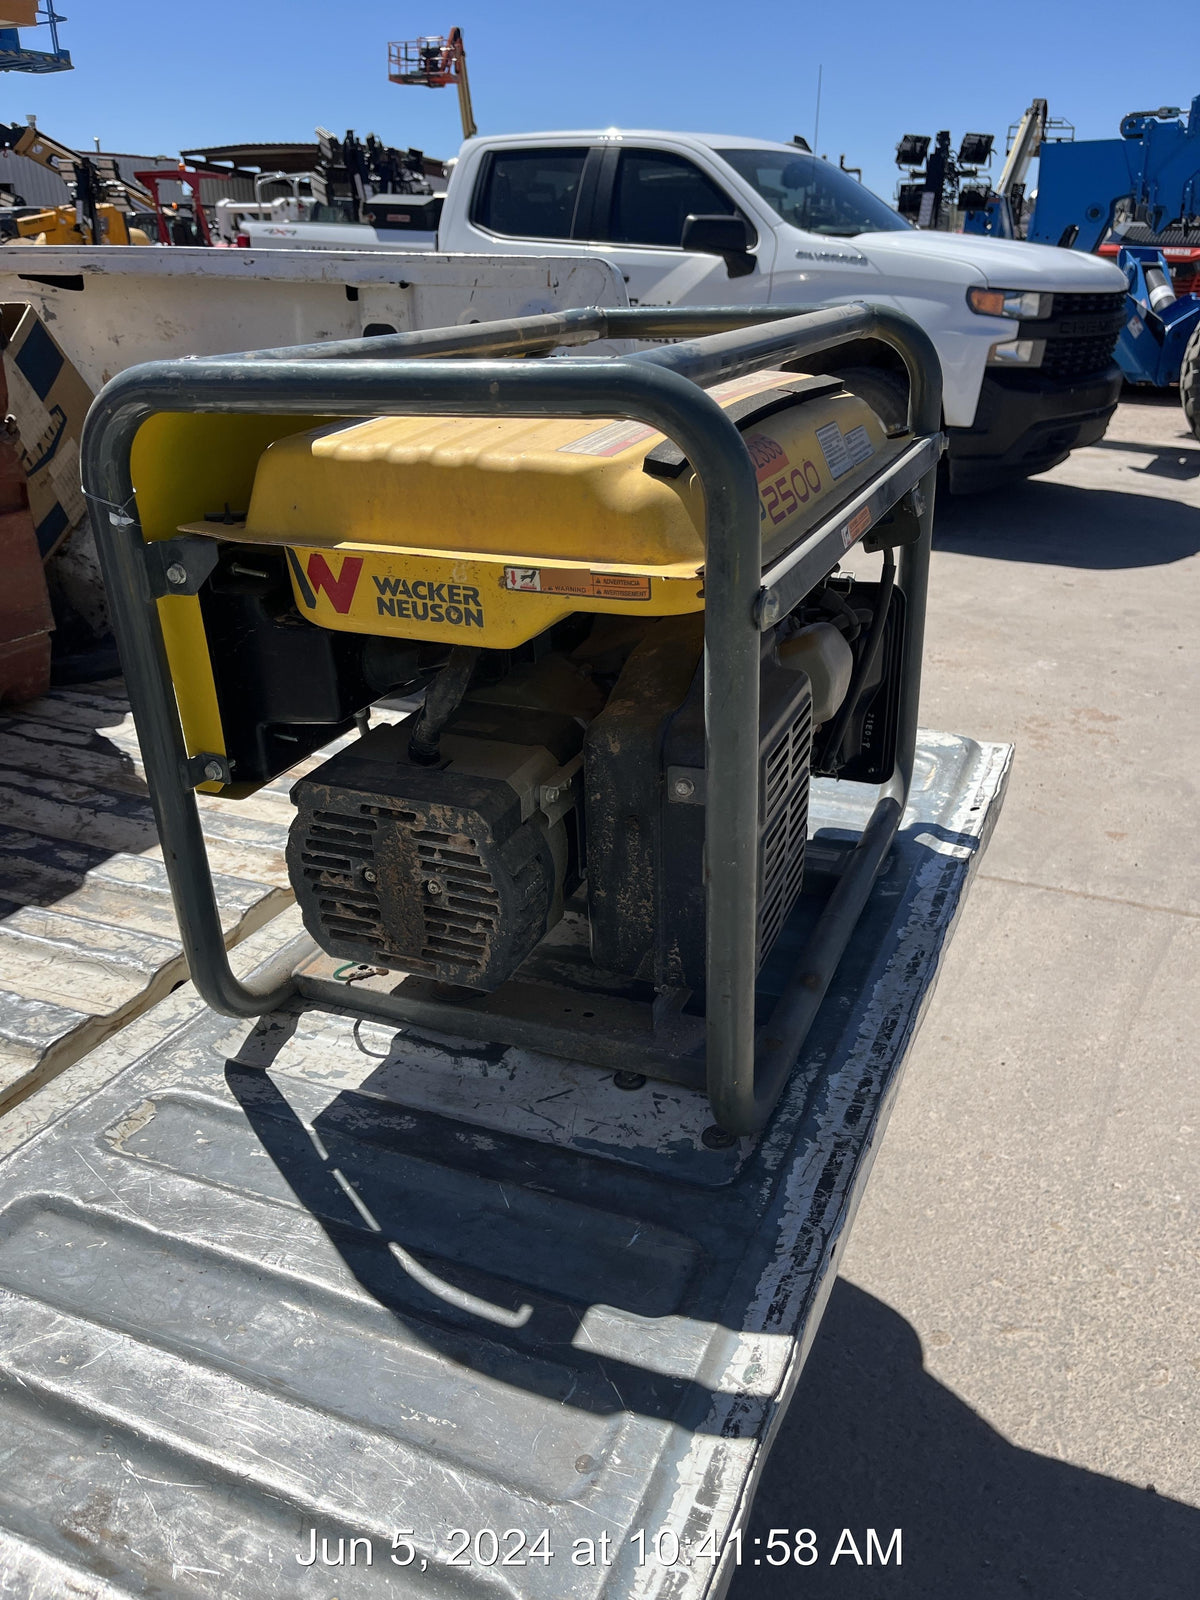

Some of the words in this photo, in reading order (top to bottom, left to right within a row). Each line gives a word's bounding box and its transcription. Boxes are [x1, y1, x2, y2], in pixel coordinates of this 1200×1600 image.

[760, 460, 822, 526] 2500
[371, 575, 483, 607] WACKER
[554, 585, 587, 594] WARNING
[376, 598, 485, 628] NEUSON
